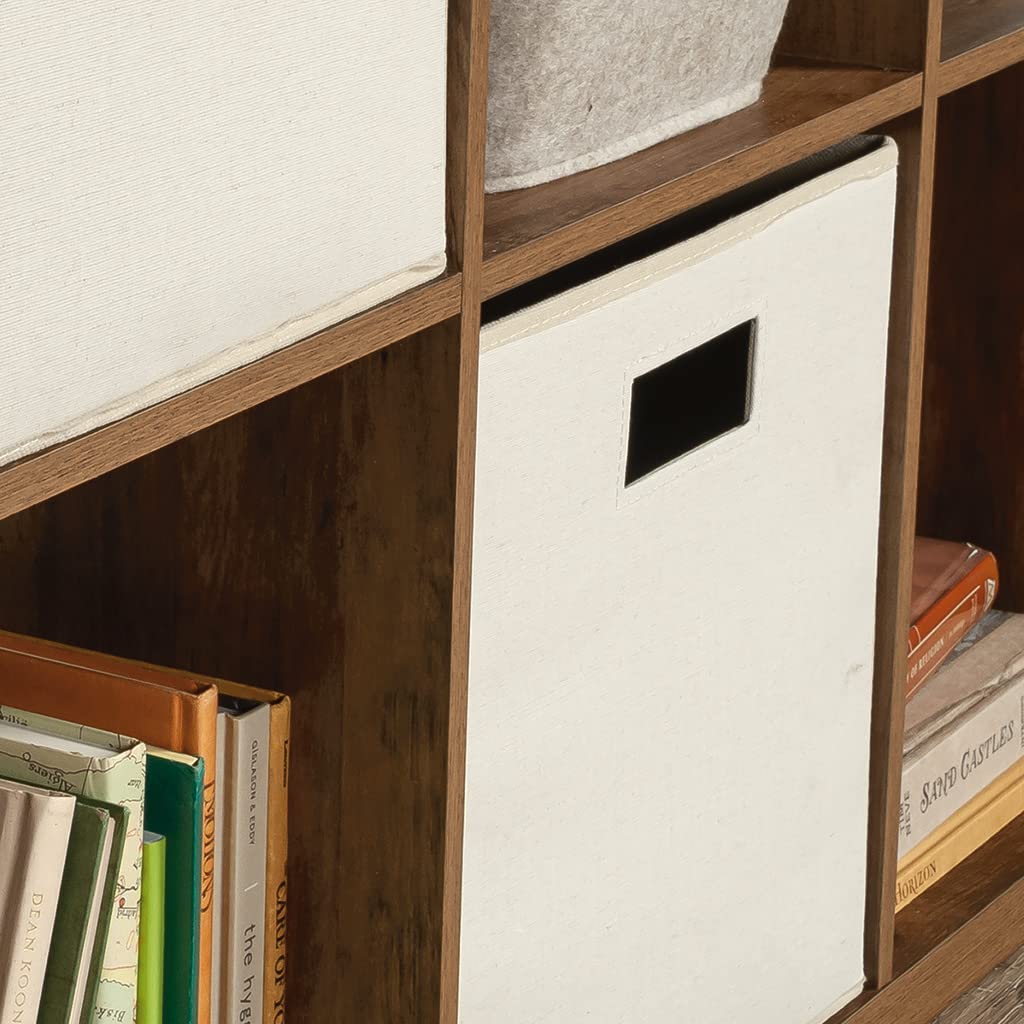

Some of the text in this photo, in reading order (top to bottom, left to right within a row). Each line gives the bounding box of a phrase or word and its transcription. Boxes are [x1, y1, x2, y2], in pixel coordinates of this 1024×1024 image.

[28, 762, 76, 793] Algiers
[919, 765, 958, 814] SAND
[960, 719, 1015, 781] CASTLES
[248, 815, 256, 846] EDDY
[23, 892, 44, 952] DEAN
[239, 924, 256, 1024] the hyg
